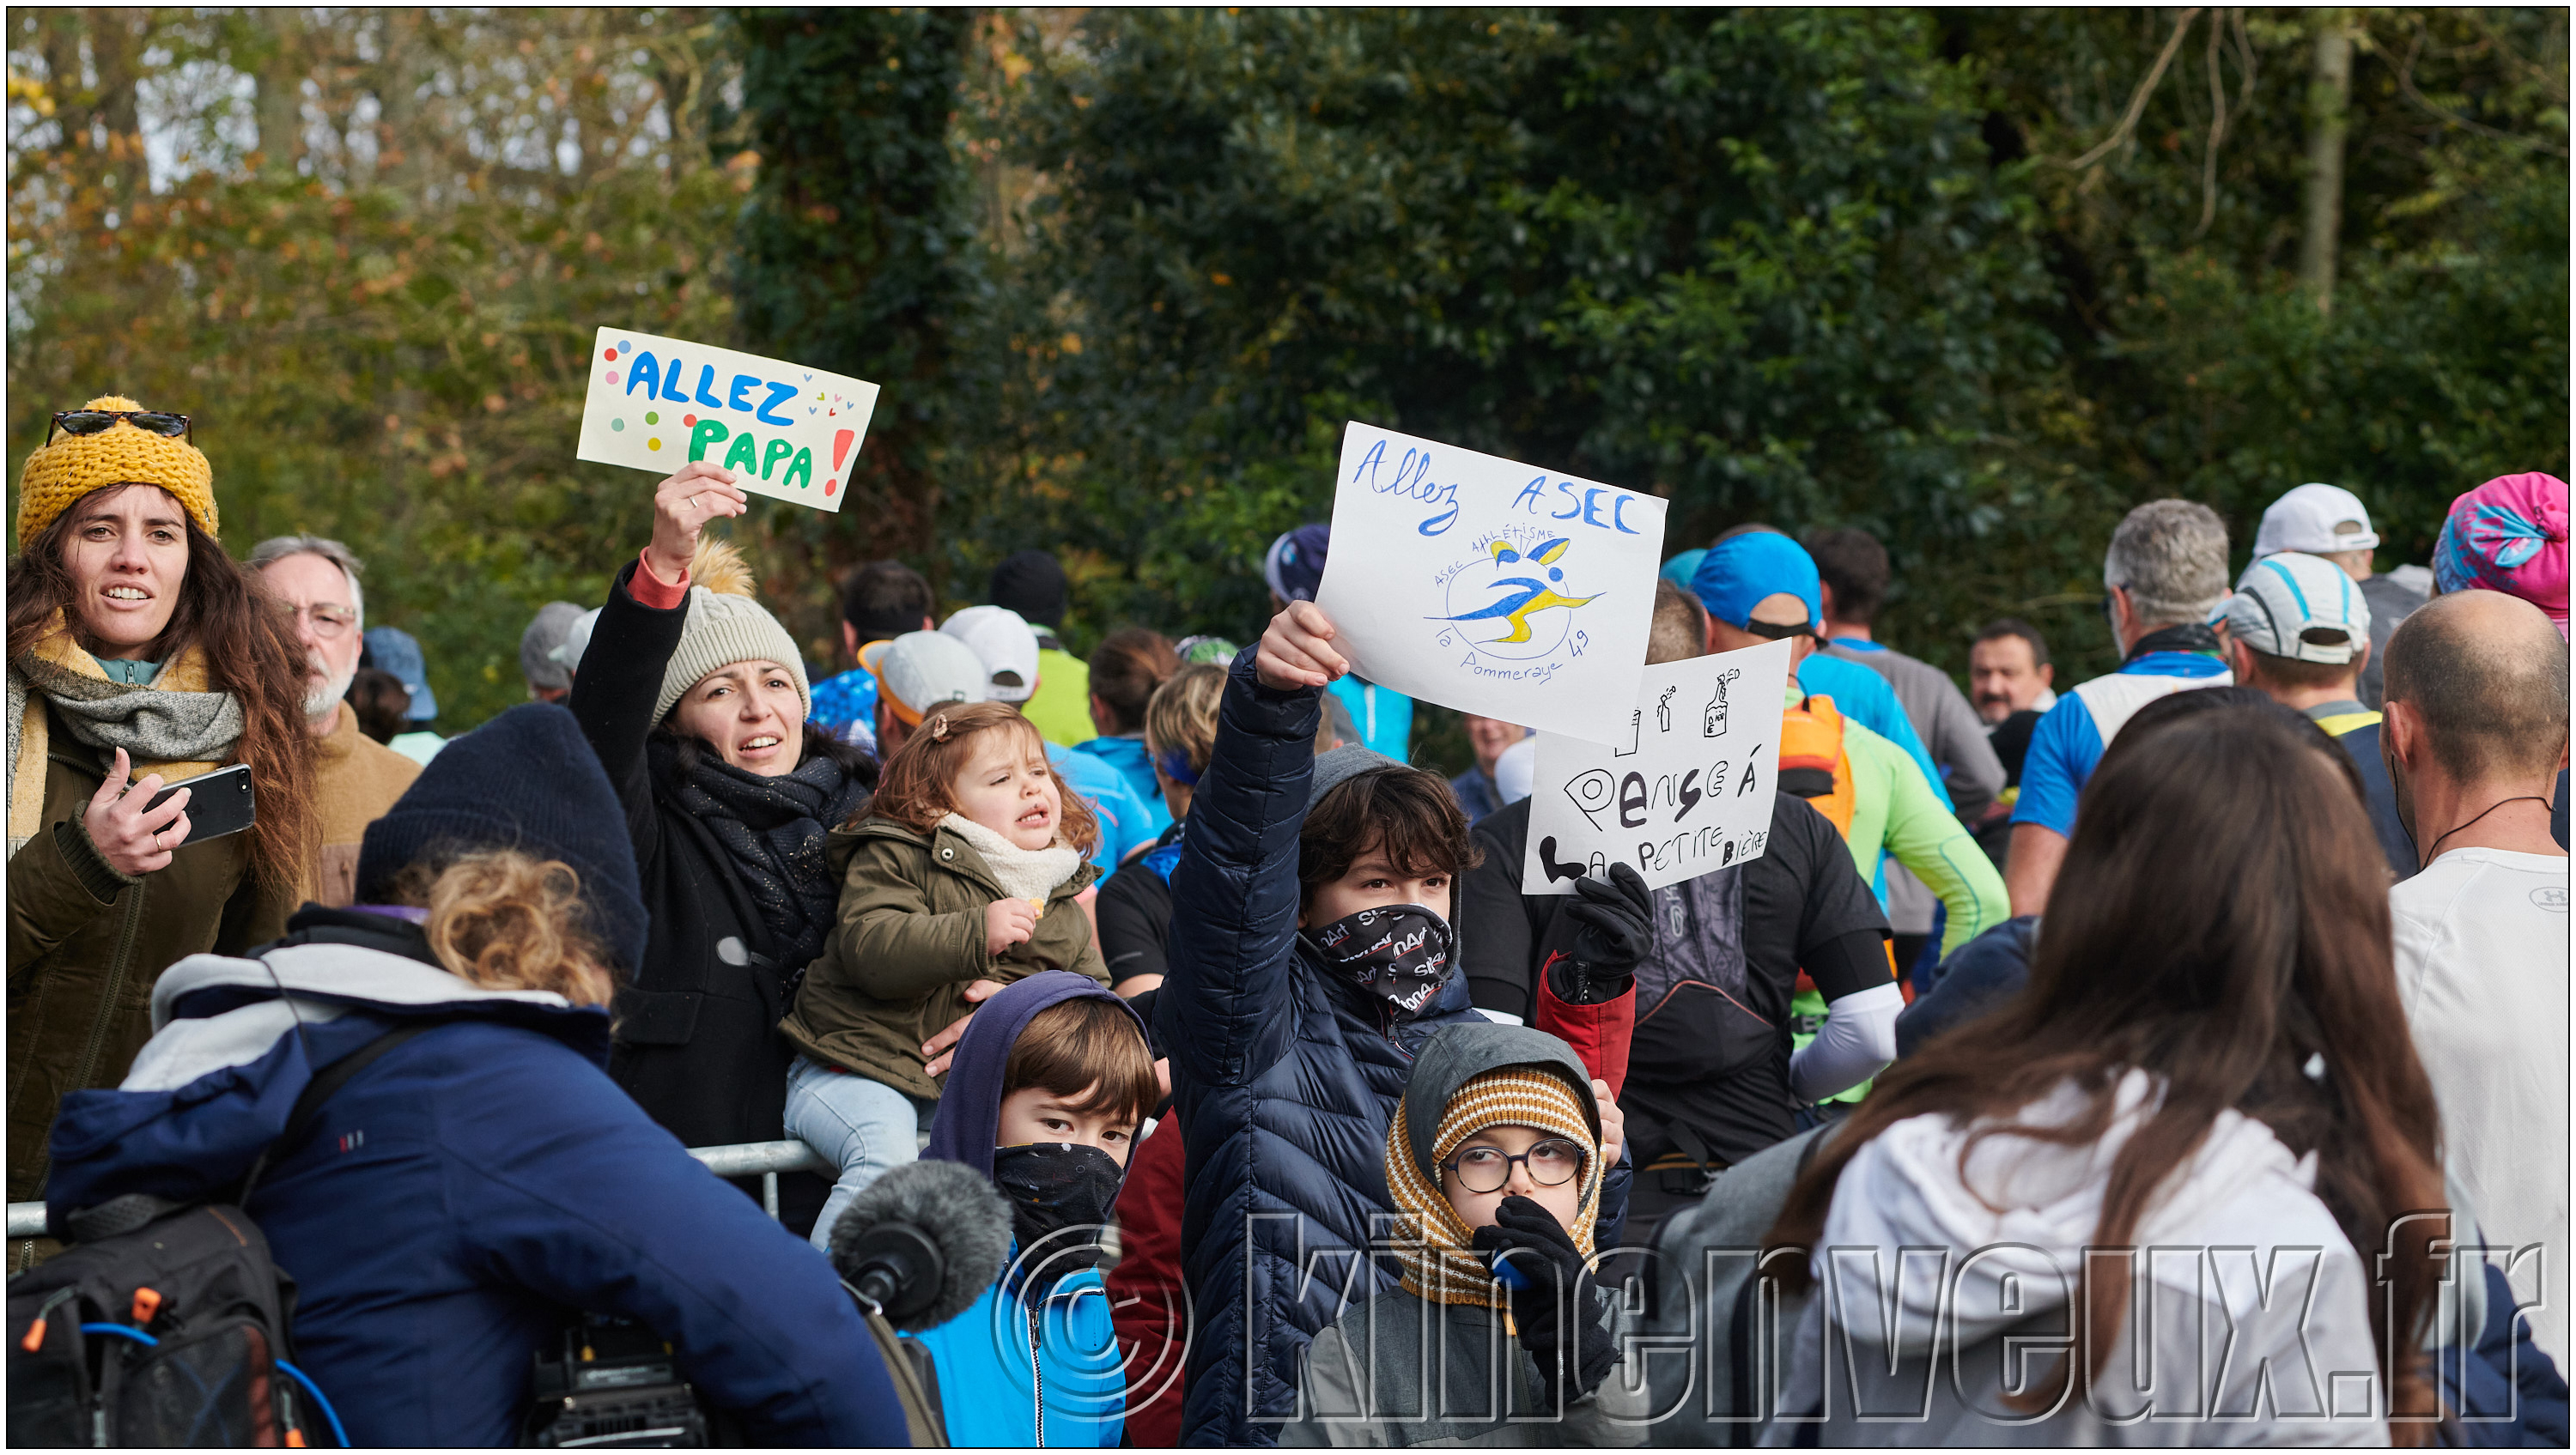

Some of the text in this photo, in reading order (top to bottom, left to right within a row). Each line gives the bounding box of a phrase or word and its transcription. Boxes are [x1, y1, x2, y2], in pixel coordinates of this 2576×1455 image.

[626, 351, 799, 426] ALLEZ
[688, 419, 812, 488] PAPA
[1352, 439, 1641, 537] Allez ASEC
[1434, 561, 1463, 587] ASEC
[1461, 652, 1564, 685] Pommeraye
[1568, 629, 1589, 658] 49
[1539, 835, 1606, 884] LA
